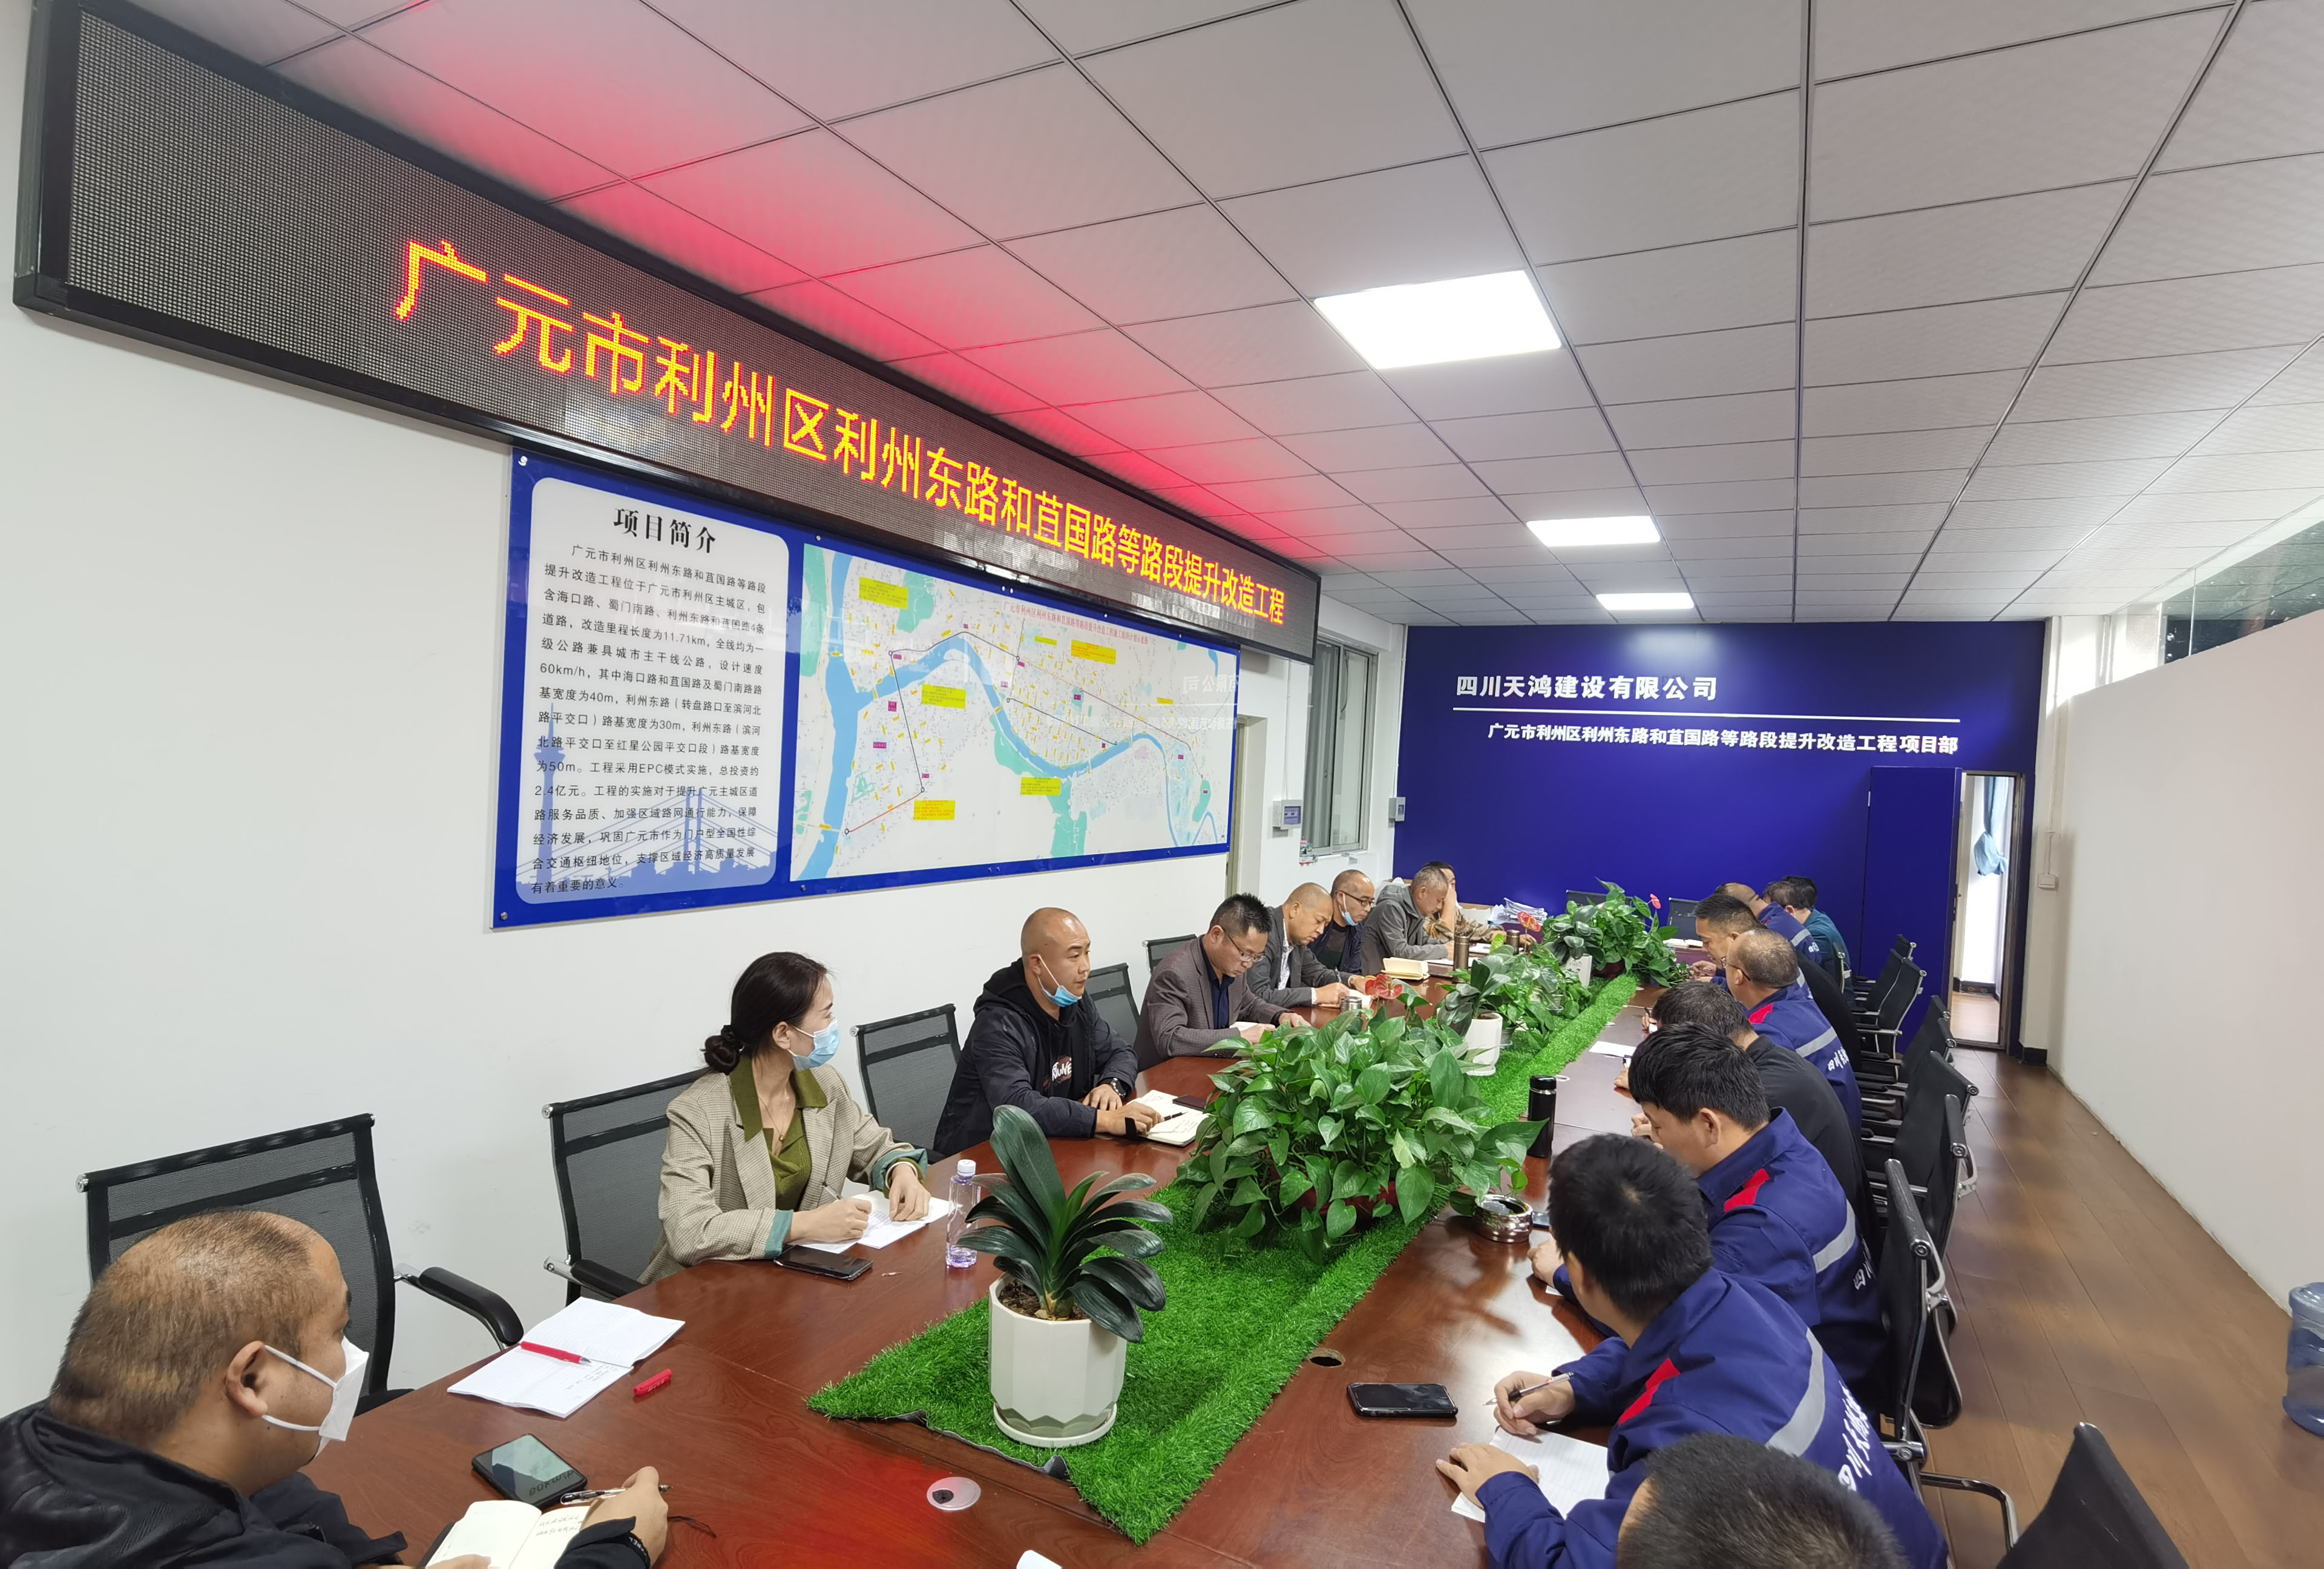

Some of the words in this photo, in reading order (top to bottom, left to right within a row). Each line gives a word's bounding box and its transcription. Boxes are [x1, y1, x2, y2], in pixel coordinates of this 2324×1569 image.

[393, 240, 1285, 625] 广元市利州区利州东路和苴国路等路段提升改造工程
[614, 508, 716, 553] 项目简介
[545, 564, 766, 614] 提升改造工程位于广元市利州区主城区，包
[572, 545, 766, 593] 广元市利州区利州东路和苴国路等路段
[1456, 675, 1718, 701] 四川天鸿建设有限公司
[1488, 722, 1958, 754] 广元市利州区利州东路和苴国路等路段提升改造工程项目部
[531, 878, 624, 894] 有着重要的意义。
